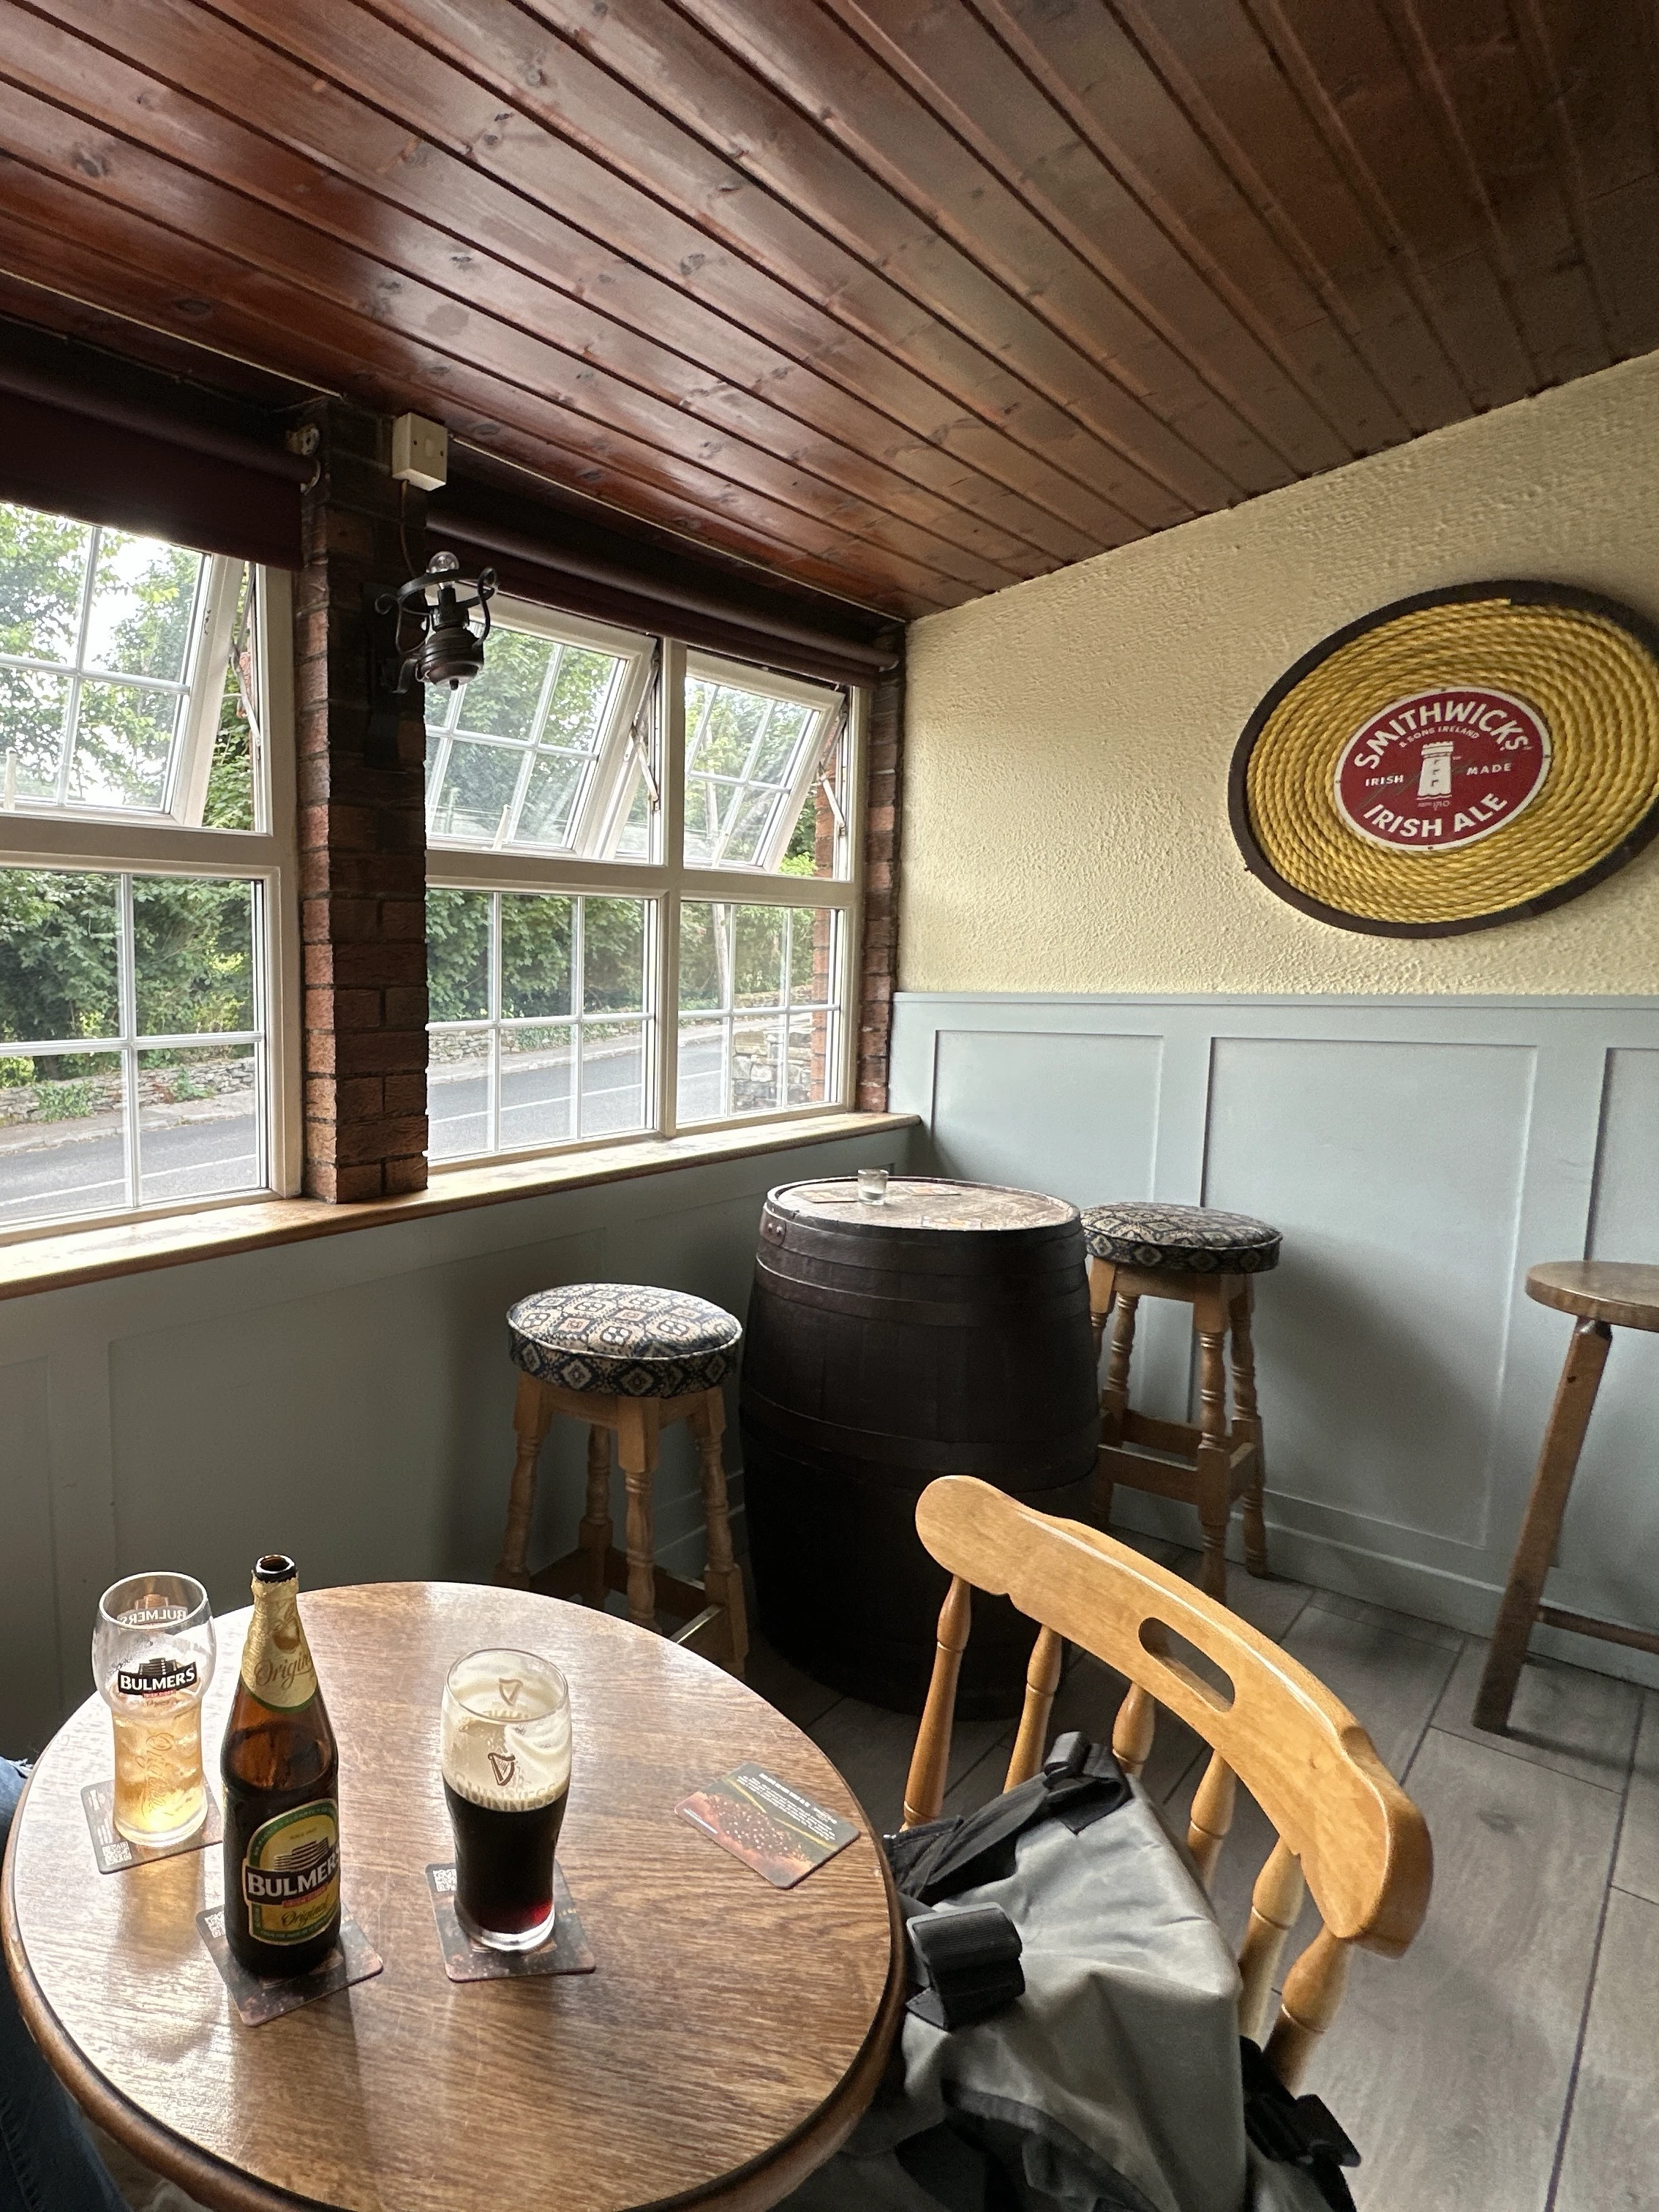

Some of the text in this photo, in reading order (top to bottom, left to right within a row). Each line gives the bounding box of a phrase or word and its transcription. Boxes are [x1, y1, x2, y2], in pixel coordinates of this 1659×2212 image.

[1407, 727, 1435, 742] SONS
[1438, 726, 1481, 740] IRELAND
[1466, 762, 1512, 776] MADE
[1365, 774, 1404, 787] IRISH
[1363, 792, 1508, 838] IRISH ALE
[120, 1668, 195, 1690] BULMERS
[254, 1652, 312, 1690] Origin
